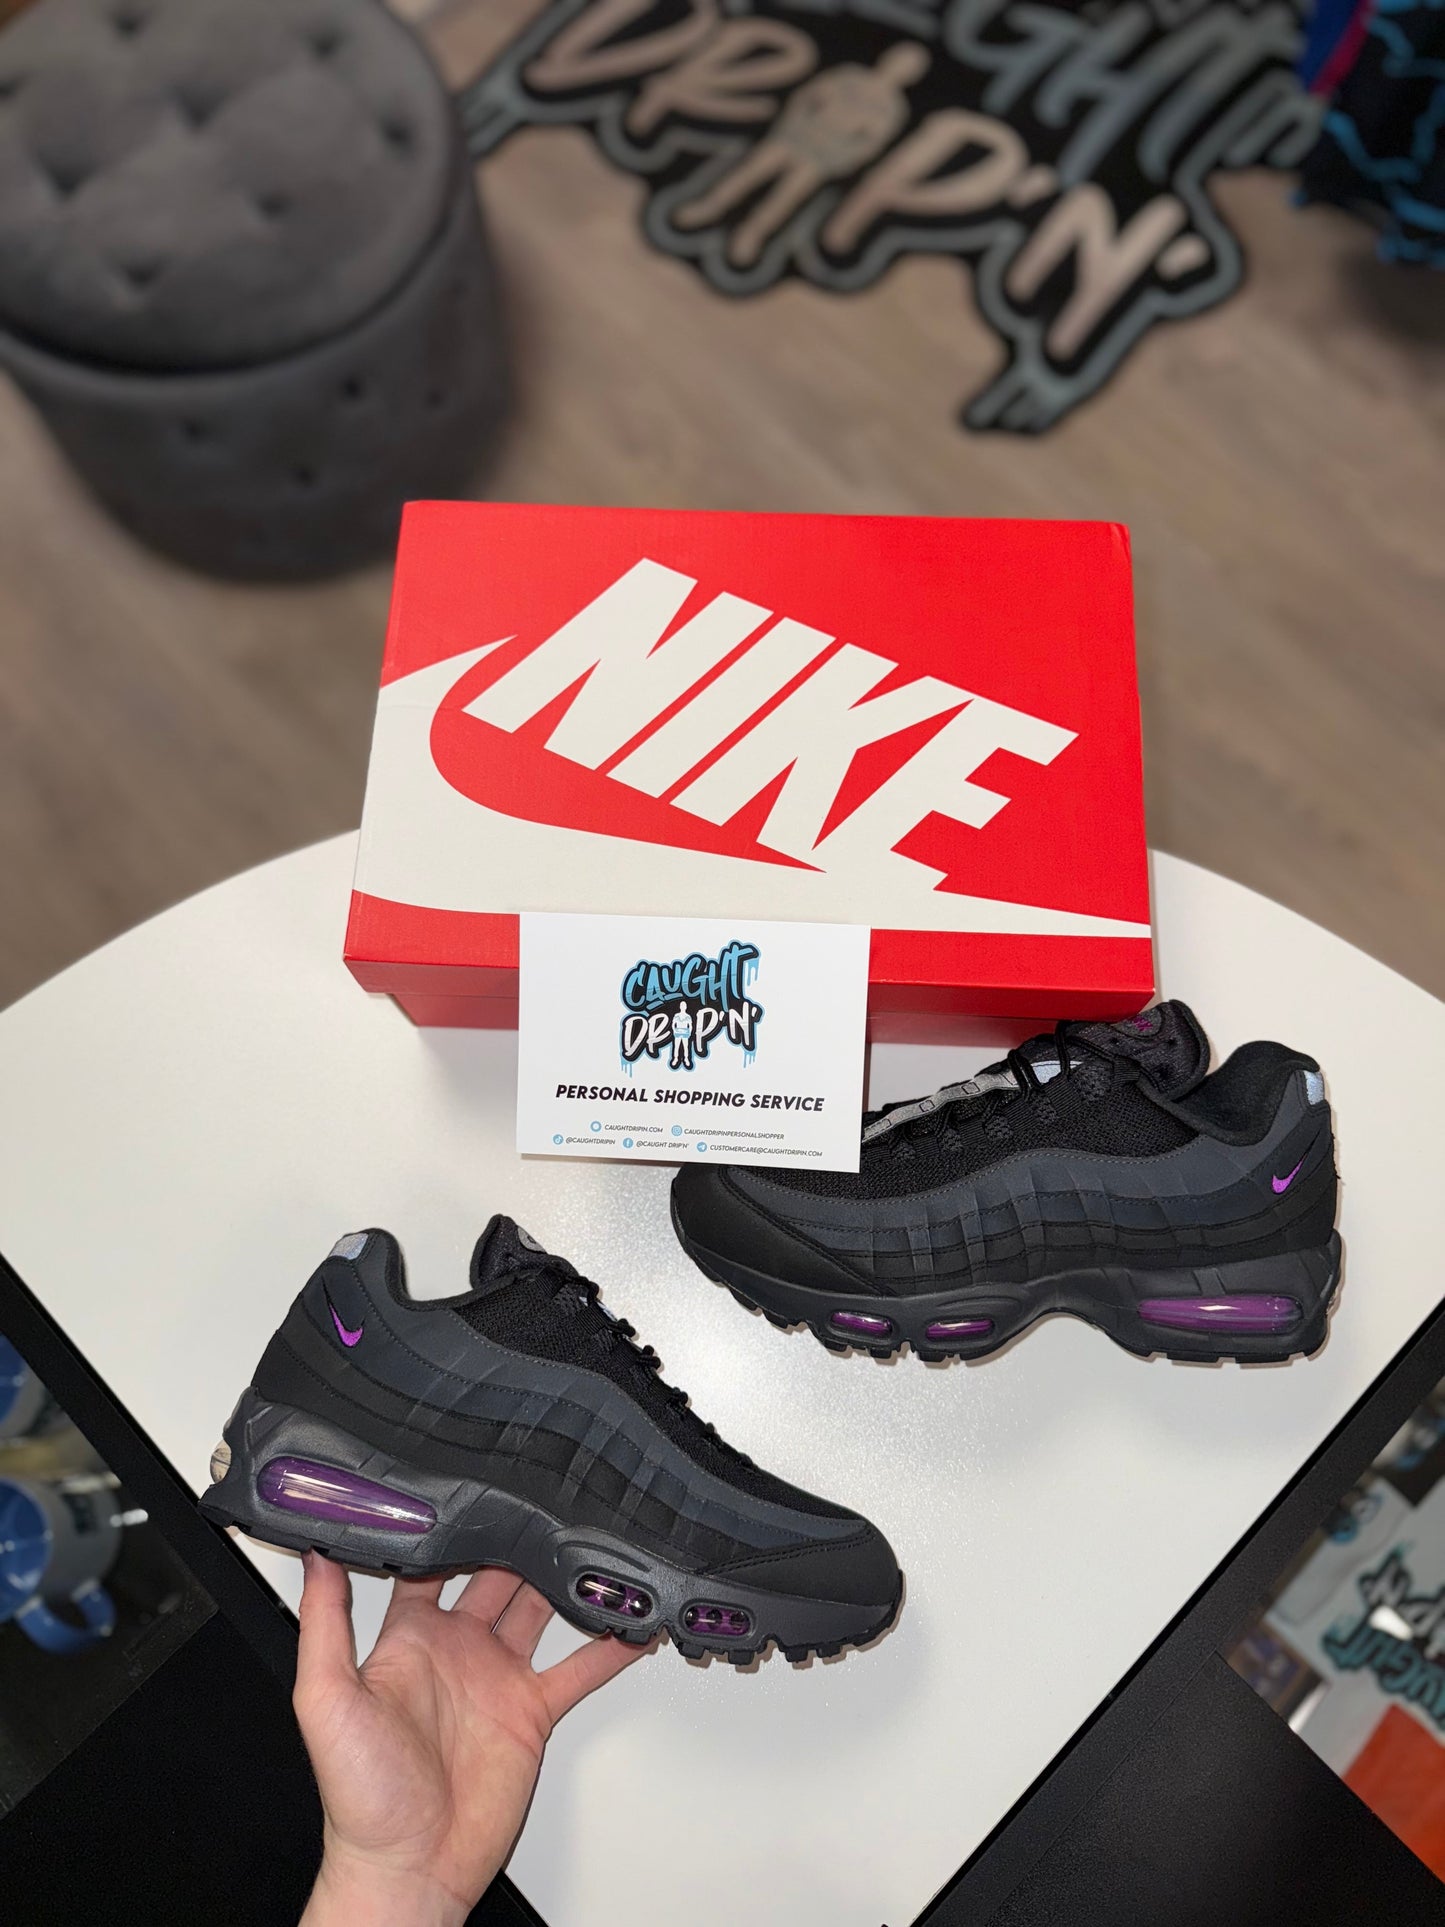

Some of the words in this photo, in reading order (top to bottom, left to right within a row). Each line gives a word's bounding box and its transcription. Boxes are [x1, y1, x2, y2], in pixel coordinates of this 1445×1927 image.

[462, 557, 1080, 892] NIKE
[624, 943, 754, 1013] CAUGHT
[556, 1084, 648, 1103] PERSONAL
[654, 1089, 746, 1107] SHOPPING
[750, 1094, 825, 1112] SERVICE
[604, 1124, 664, 1133] CAUGHTDRIPIN.COM
[684, 1128, 785, 1140] CAUGHTDRIPINPERSONALSHOPPER
[709, 1144, 823, 1157] CUSTOMERCARE@CAUGHTDRIPIN.COM
